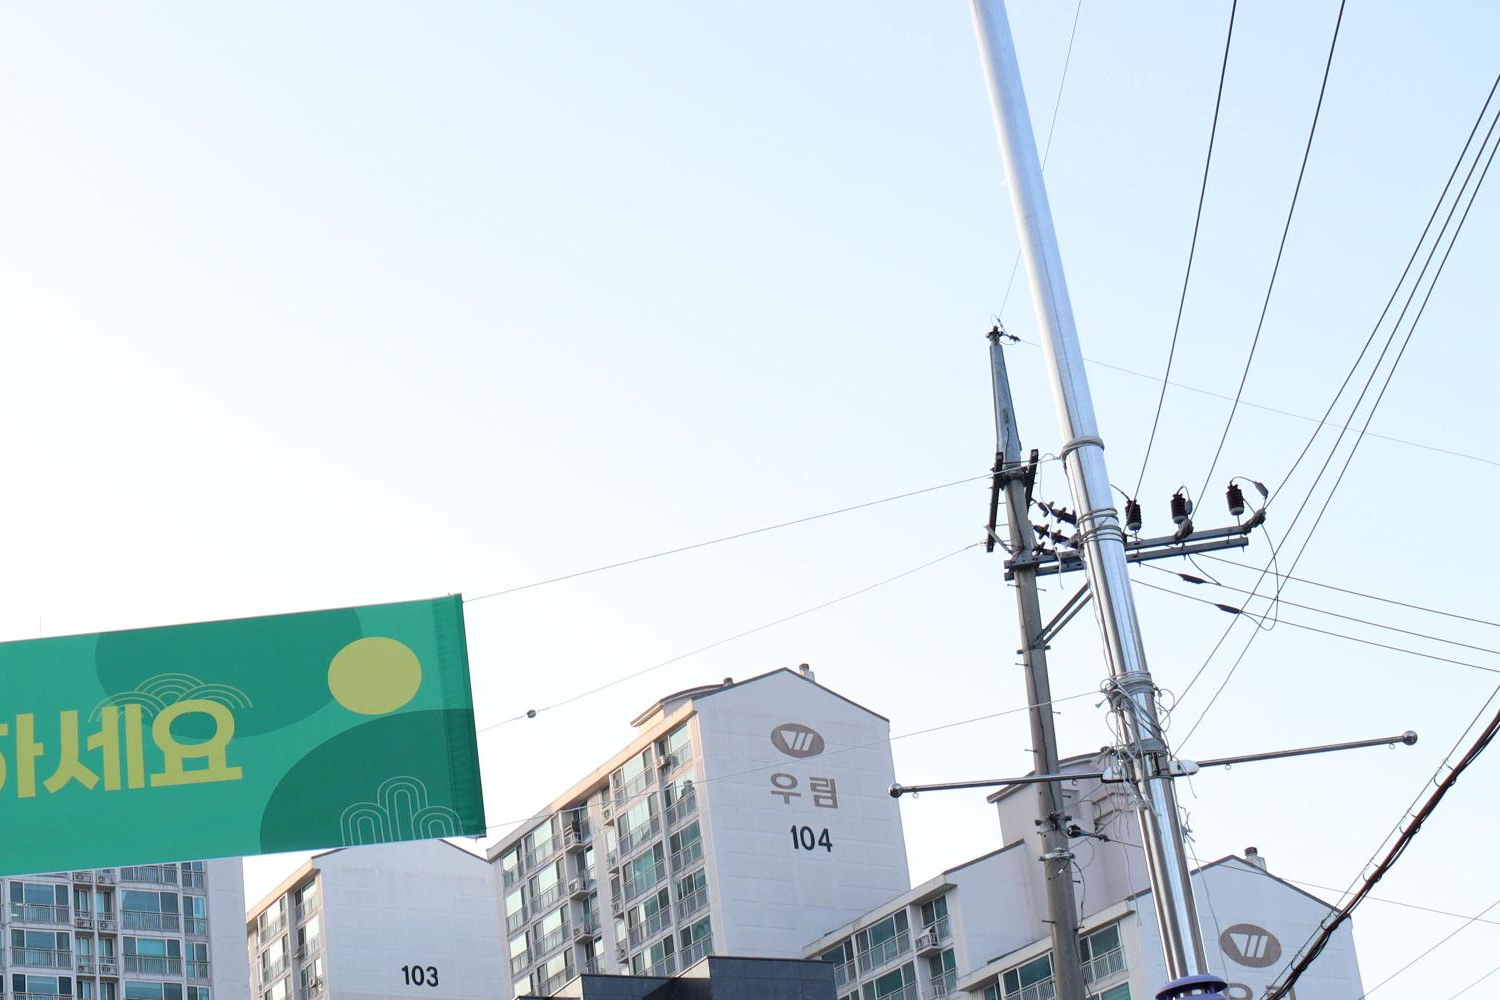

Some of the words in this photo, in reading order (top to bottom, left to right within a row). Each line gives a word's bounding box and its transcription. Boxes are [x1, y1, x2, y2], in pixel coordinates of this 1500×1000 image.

[771, 773, 838, 809] 우림
[790, 825, 833, 853] 104
[401, 965, 439, 988] 103
